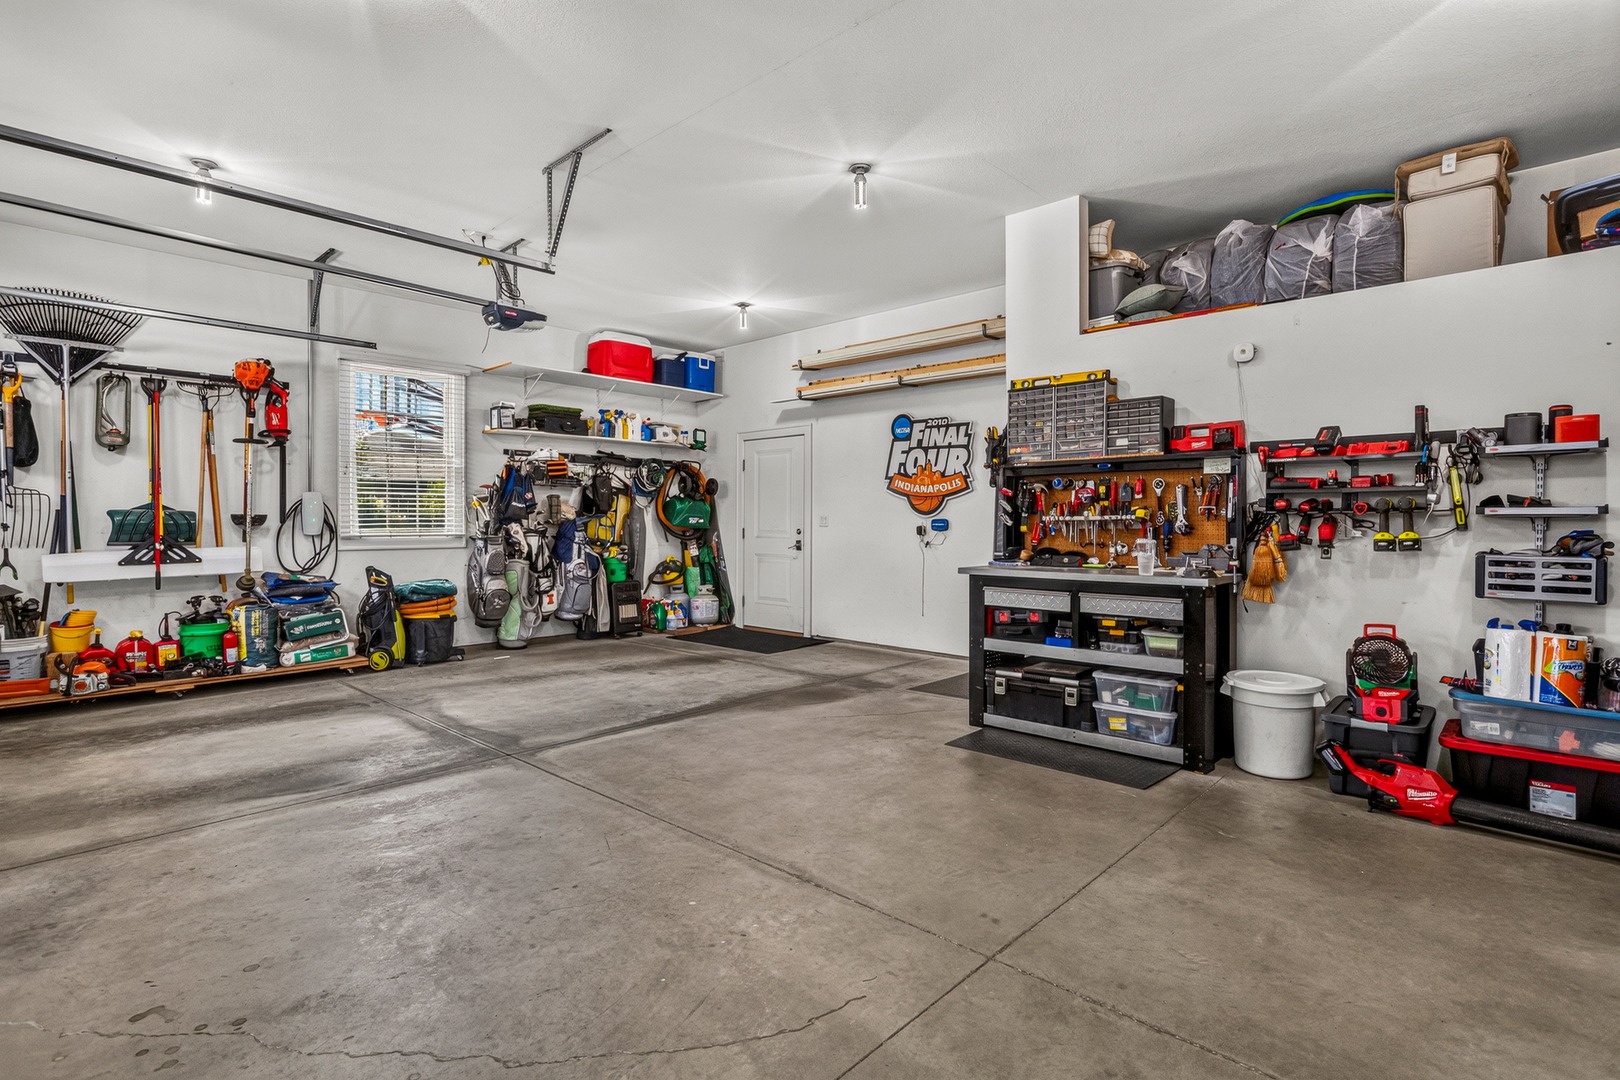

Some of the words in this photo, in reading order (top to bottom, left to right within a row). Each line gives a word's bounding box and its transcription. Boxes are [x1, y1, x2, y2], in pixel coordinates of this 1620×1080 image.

[909, 422, 969, 448] FINAL
[888, 440, 969, 478] FOUR
[894, 478, 962, 493] INDIANAPOLIS
